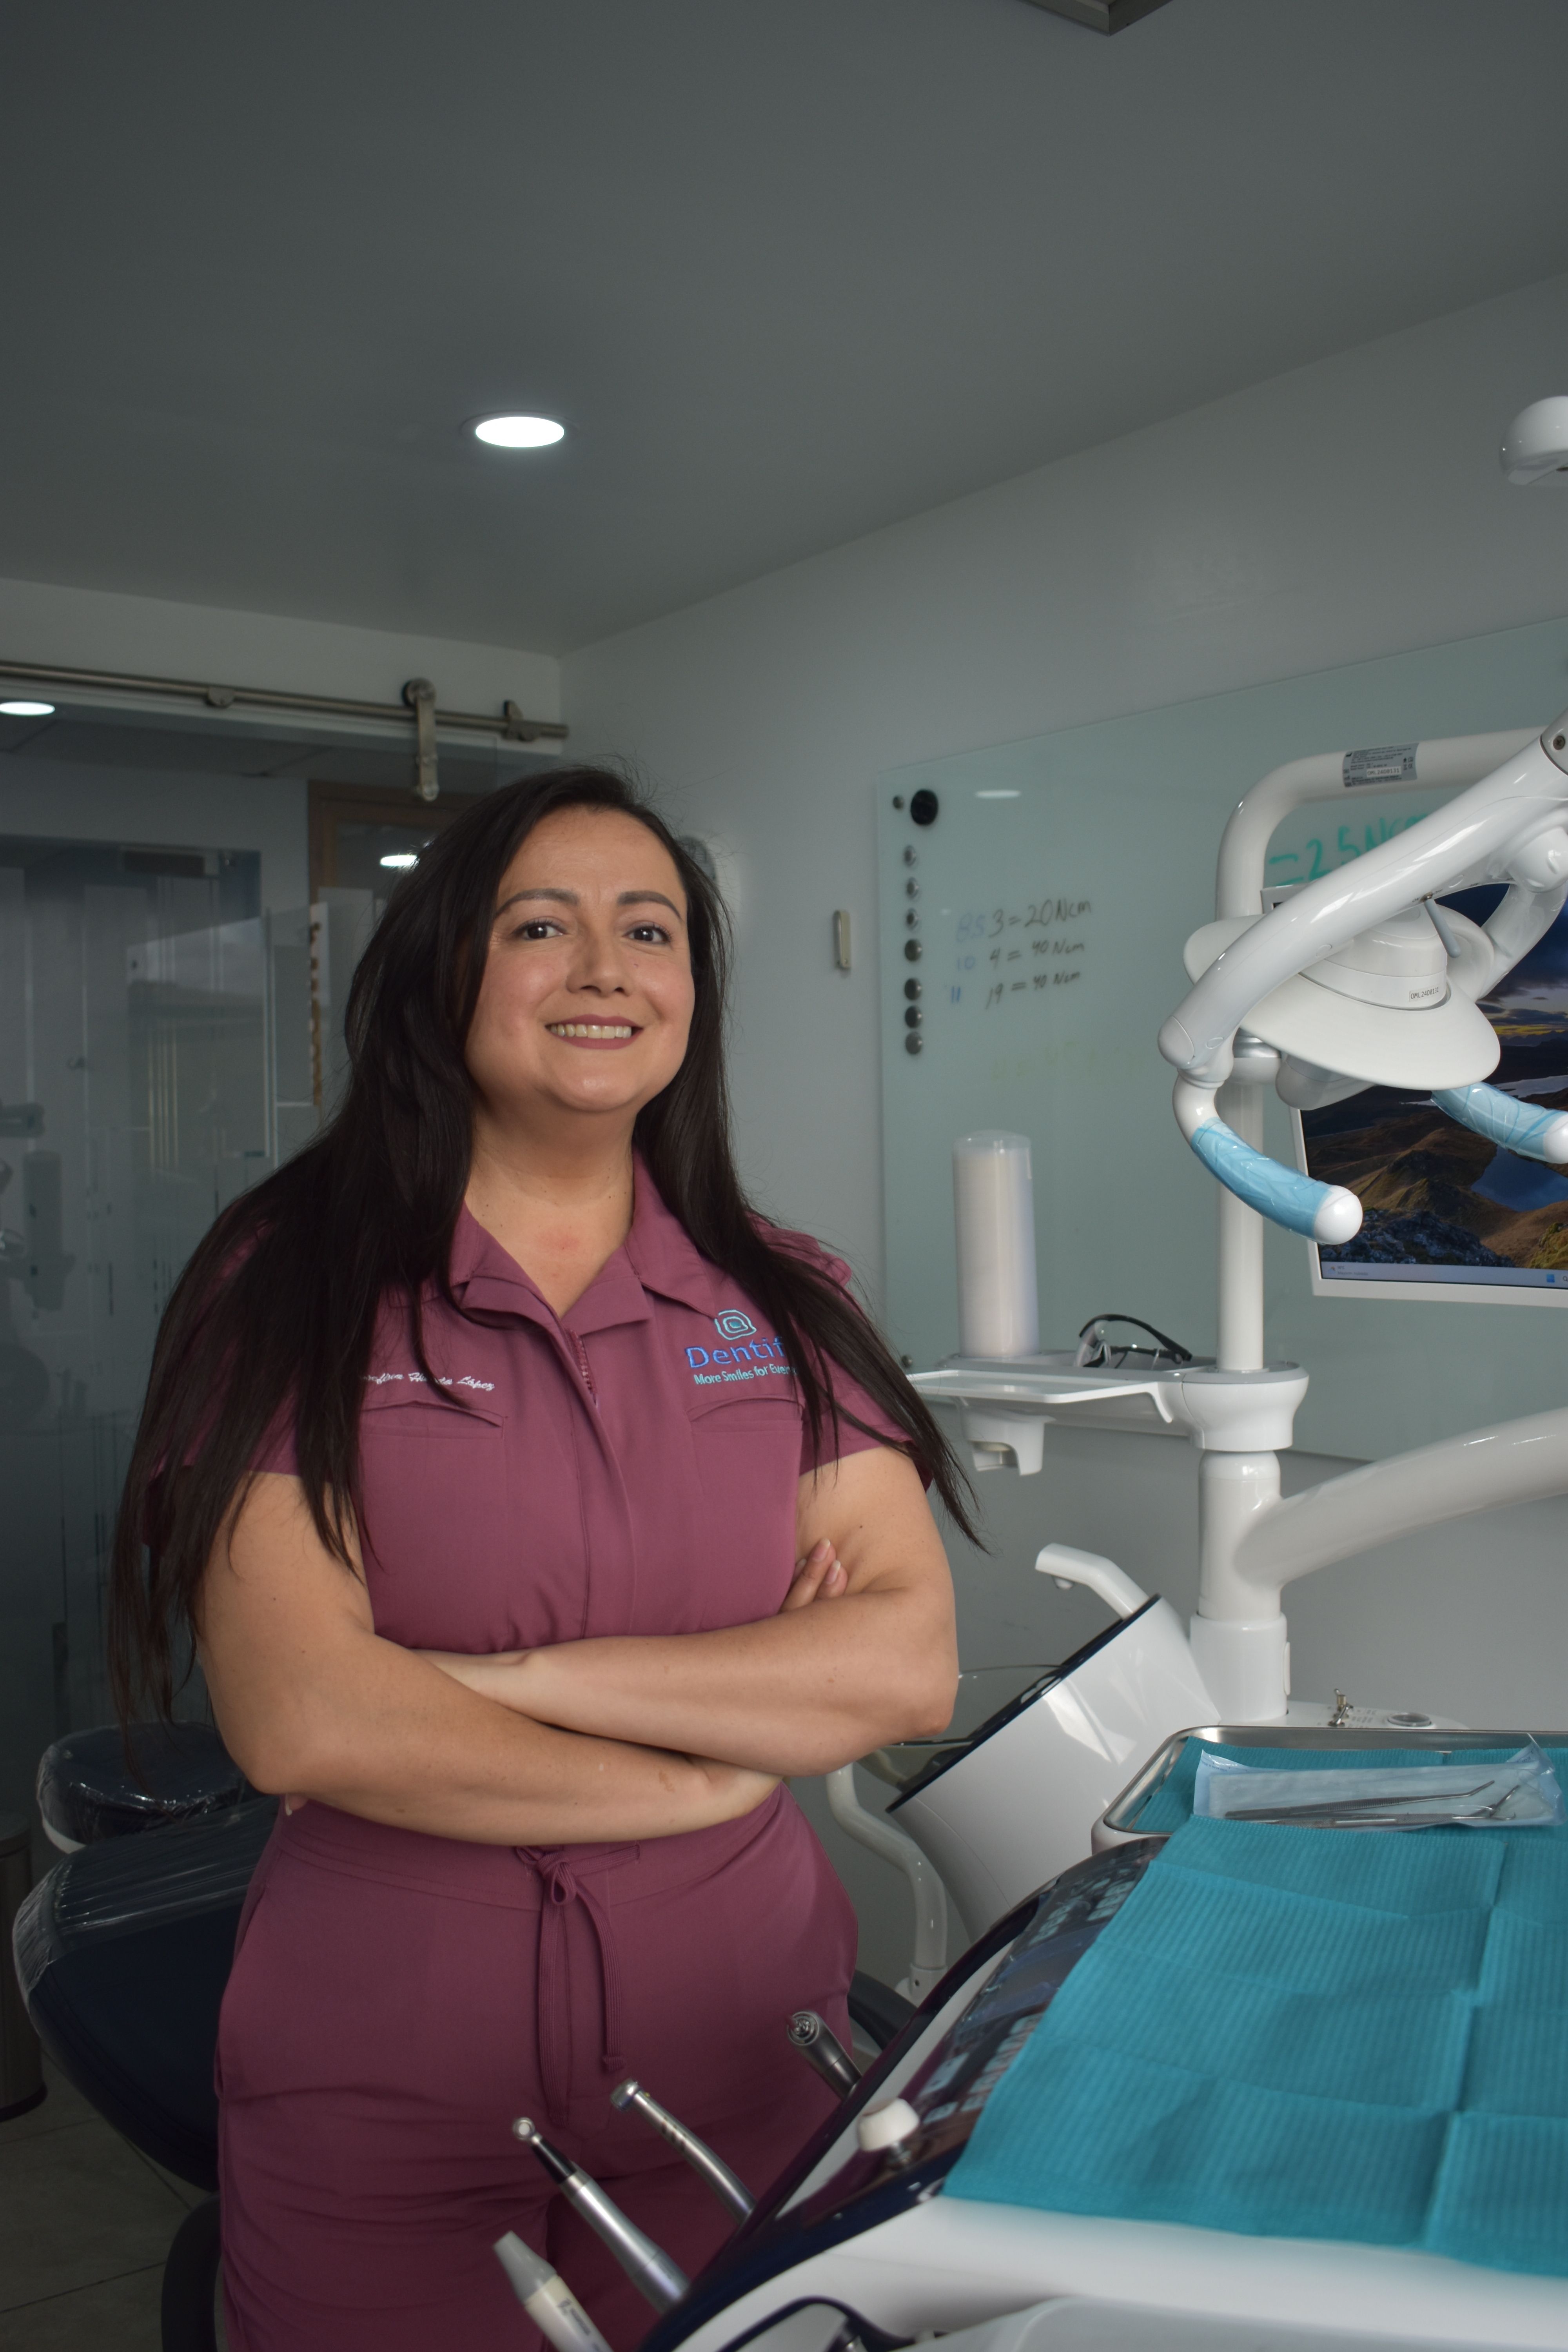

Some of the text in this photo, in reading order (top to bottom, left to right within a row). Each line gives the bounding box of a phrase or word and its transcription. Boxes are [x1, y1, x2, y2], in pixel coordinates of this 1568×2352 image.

[685, 1336, 785, 1368] Dentif
[694, 1374, 722, 1385] More
[721, 1368, 754, 1381] Smiles
[754, 1366, 768, 1376] for
